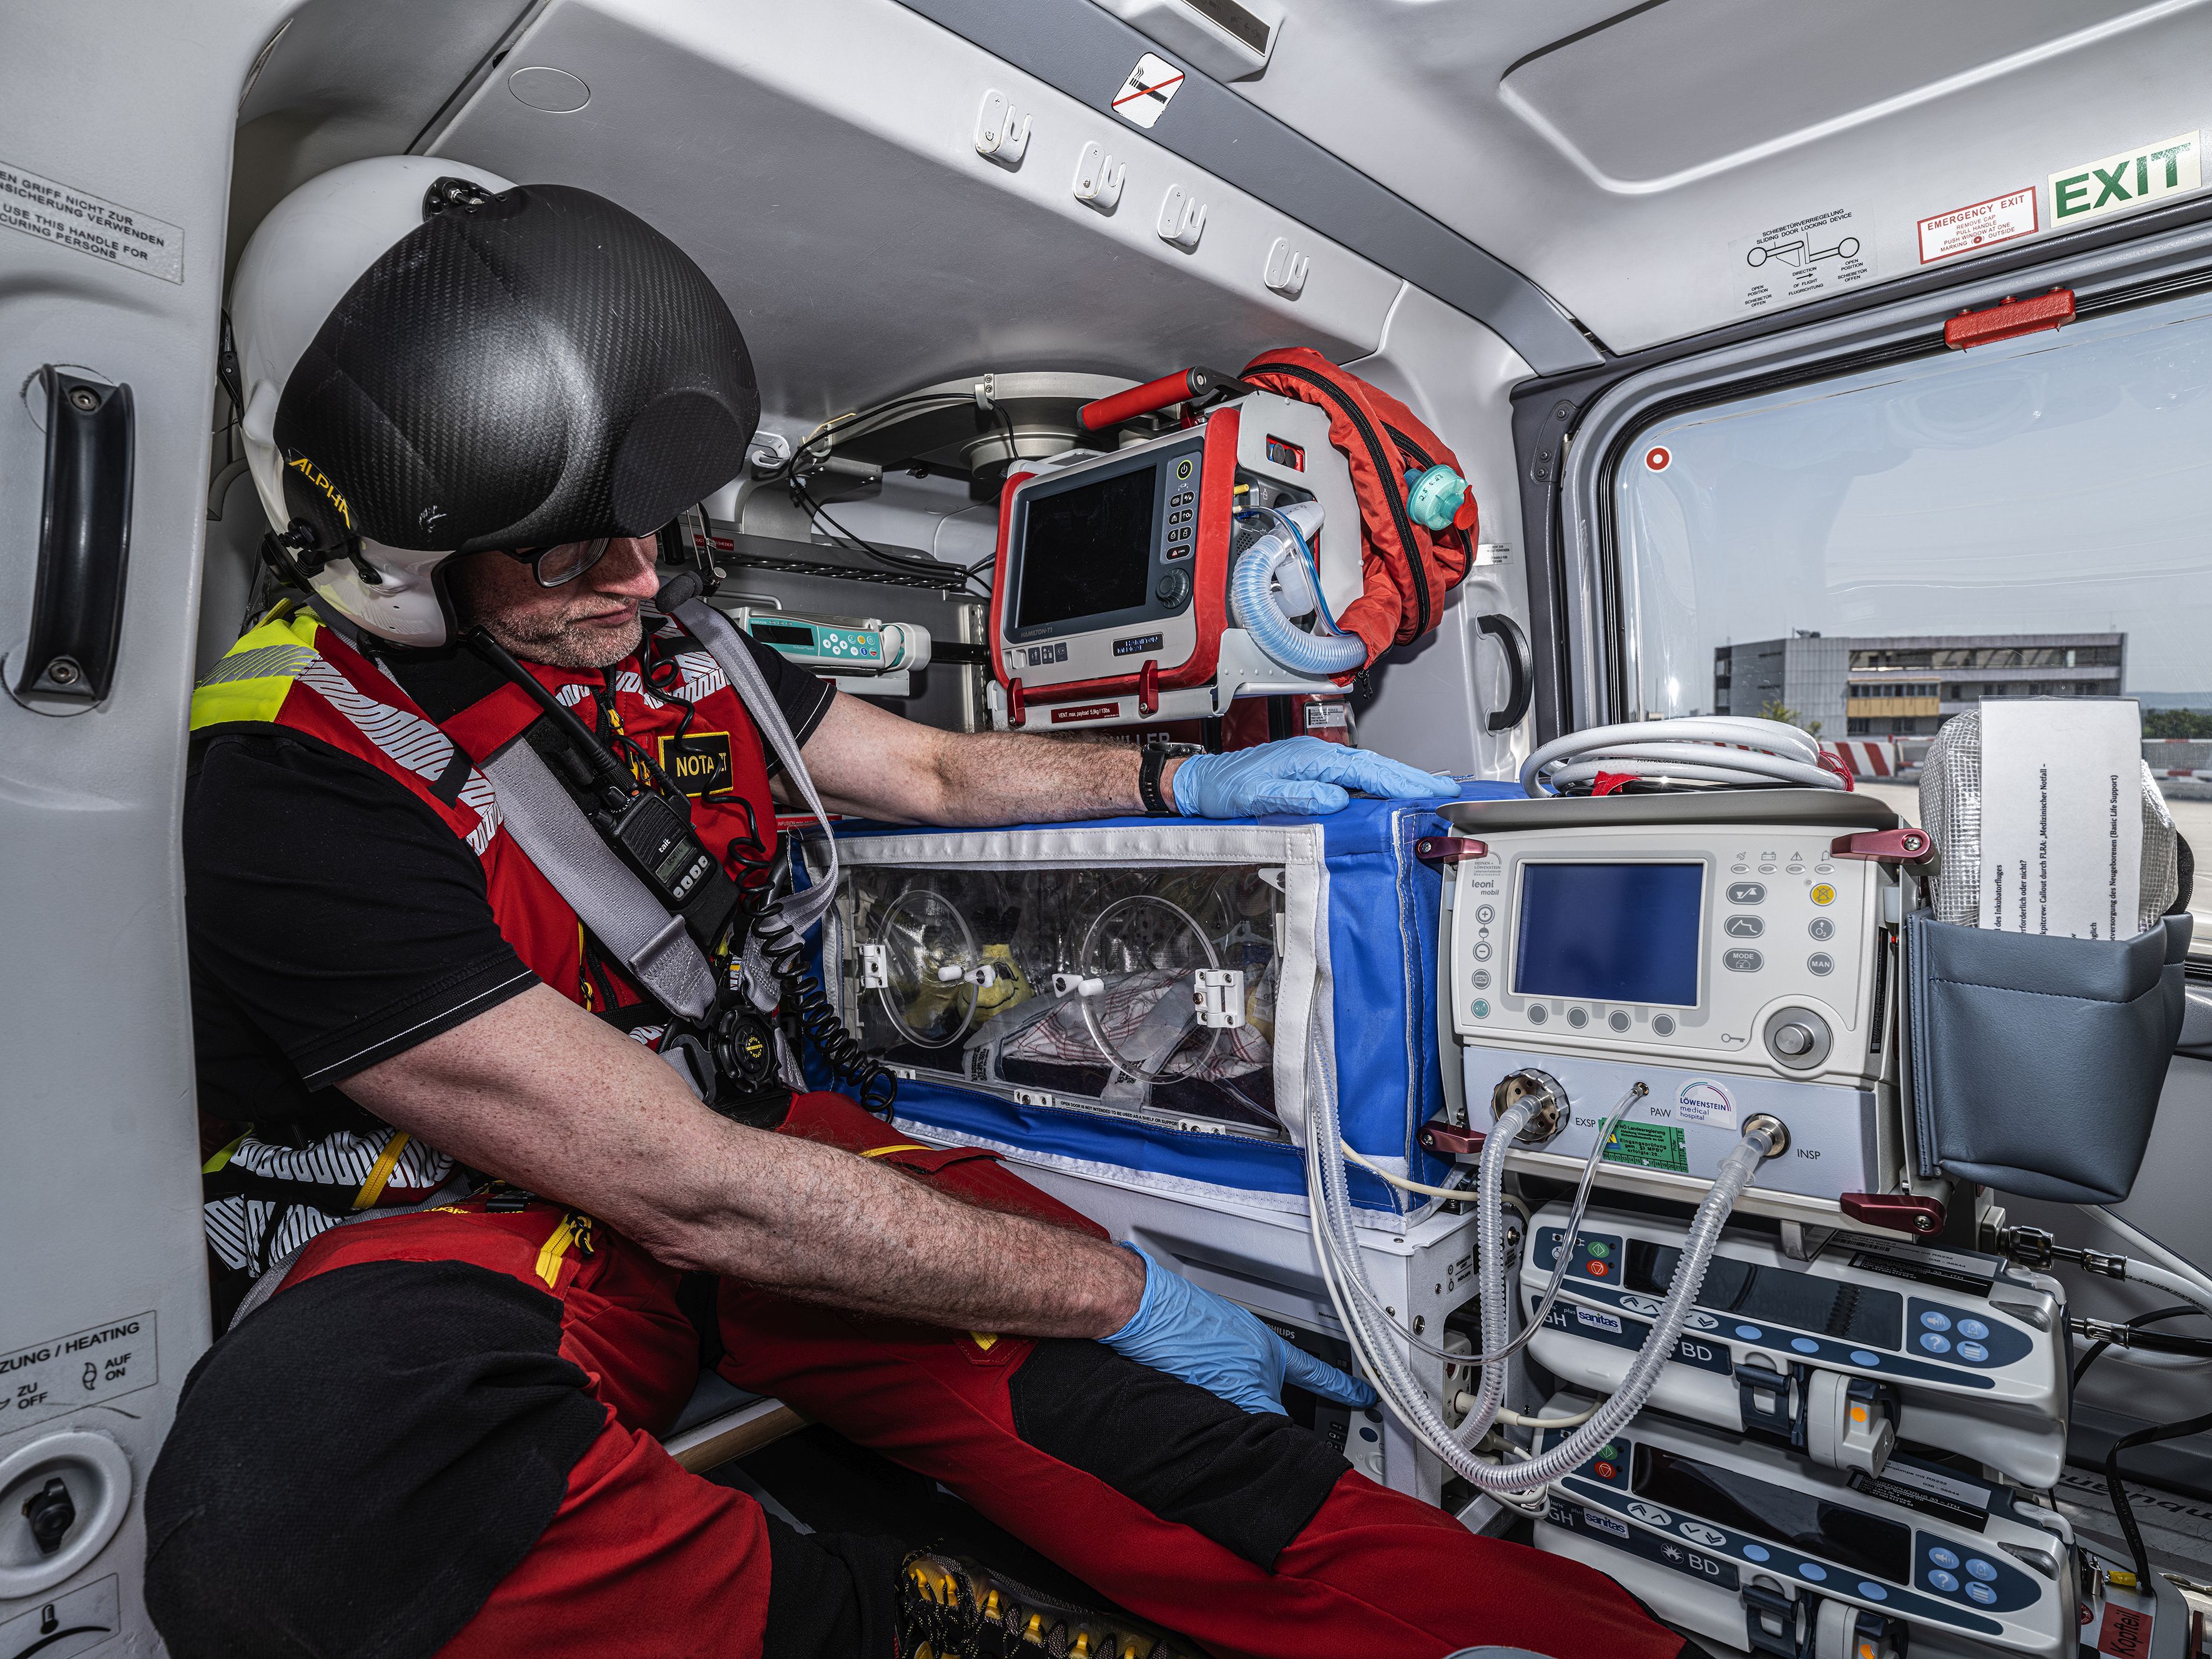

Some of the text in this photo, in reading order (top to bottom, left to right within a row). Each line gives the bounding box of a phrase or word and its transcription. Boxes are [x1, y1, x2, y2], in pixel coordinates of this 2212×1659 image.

[2055, 142, 2191, 219] EXIT
[22, 179, 61, 199] GRIFF
[66, 195, 104, 214] NICHT
[109, 210, 133, 226] ZUR
[1927, 195, 2024, 230] EMERGENCY EXIT
[87, 212, 164, 247] VERWENDEN
[1757, 212, 1852, 245] SLIDING DOOR LOCKING DEVICE
[1762, 209, 1844, 237] SCHIEBETÜRVERRIEGELUNG
[1957, 214, 1996, 230] REMOVE CAP
[1962, 230, 1987, 240] WINDOW
[1998, 222, 2010, 230] ONE
[1973, 220, 1997, 231] HANDLE
[3, 203, 148, 260] USE THIS HANDLE FOR
[1940, 241, 1967, 252] MARKING
[1988, 227, 2015, 239] OUTSIDE
[56, 232, 117, 259] PERSONS
[1792, 267, 1817, 276] DIRECTION
[1838, 268, 1867, 280] SCHIEBETÜR
[1841, 262, 1863, 271] POSITION
[1748, 288, 1768, 297] POSITION
[1789, 283, 1823, 296] FLUGRICHTUNG
[1745, 294, 1772, 305] SCHIEBETÜR
[288, 458, 351, 529] ALPHA
[2110, 775, 2118, 804] Support)
[2110, 818, 2118, 838] (Basic
[1472, 880, 1493, 888] leoni
[1995, 865, 2003, 915] Inkubatorfluges
[1680, 1096, 1726, 1111] LÖWENSTEIN
[1680, 1105, 1709, 1115] medical
[1651, 1108, 1671, 1118] PAW
[1680, 1111, 1705, 1120] hospital
[1575, 1118, 1596, 1128] EXSP
[1628, 1126, 1665, 1135] Landesregierung
[1620, 1138, 1666, 1149] Eingangsprüfung
[1797, 1149, 1821, 1160] INSP
[1579, 1311, 1618, 1327] sanitas
[66, 1322, 140, 1354] HEATING
[1681, 1341, 1713, 1361] BD
[105, 1352, 132, 1370] AUF
[106, 1367, 125, 1381] ON
[17, 1383, 38, 1397] ZU
[18, 1392, 47, 1410] OFF
[1927, 1477, 1947, 1485] RS232
[1549, 1508, 1574, 1527] GH
[1586, 1513, 1626, 1533] sanitas
[1689, 1553, 1719, 1575] BD
[2110, 1609, 2143, 1657] Kopfteil
